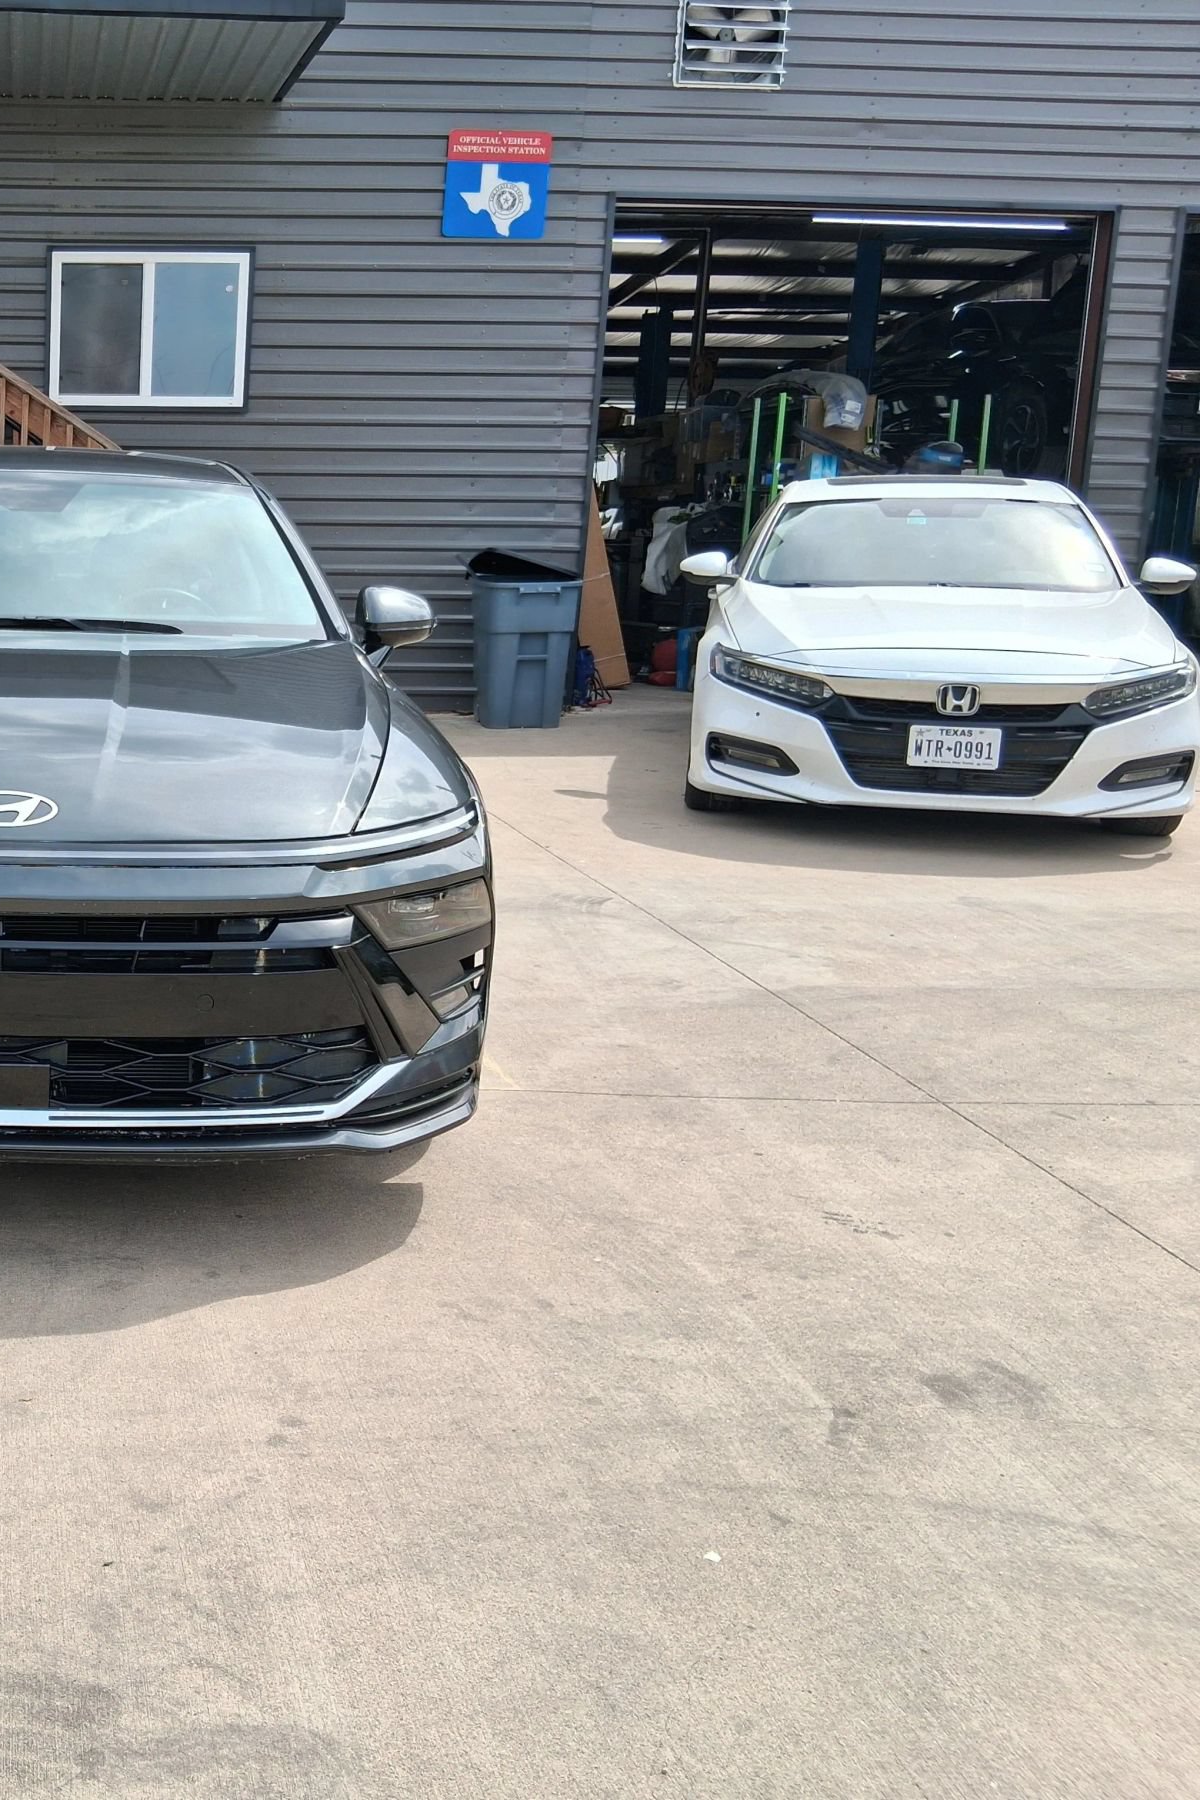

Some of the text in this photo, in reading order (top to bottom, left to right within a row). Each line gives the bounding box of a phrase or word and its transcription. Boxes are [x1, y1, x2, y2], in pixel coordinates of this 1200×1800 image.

[459, 136, 541, 145] OFFICIAL VEHICLE
[453, 145, 545, 154] INSPECTION STATION
[939, 728, 973, 737] TEXAS
